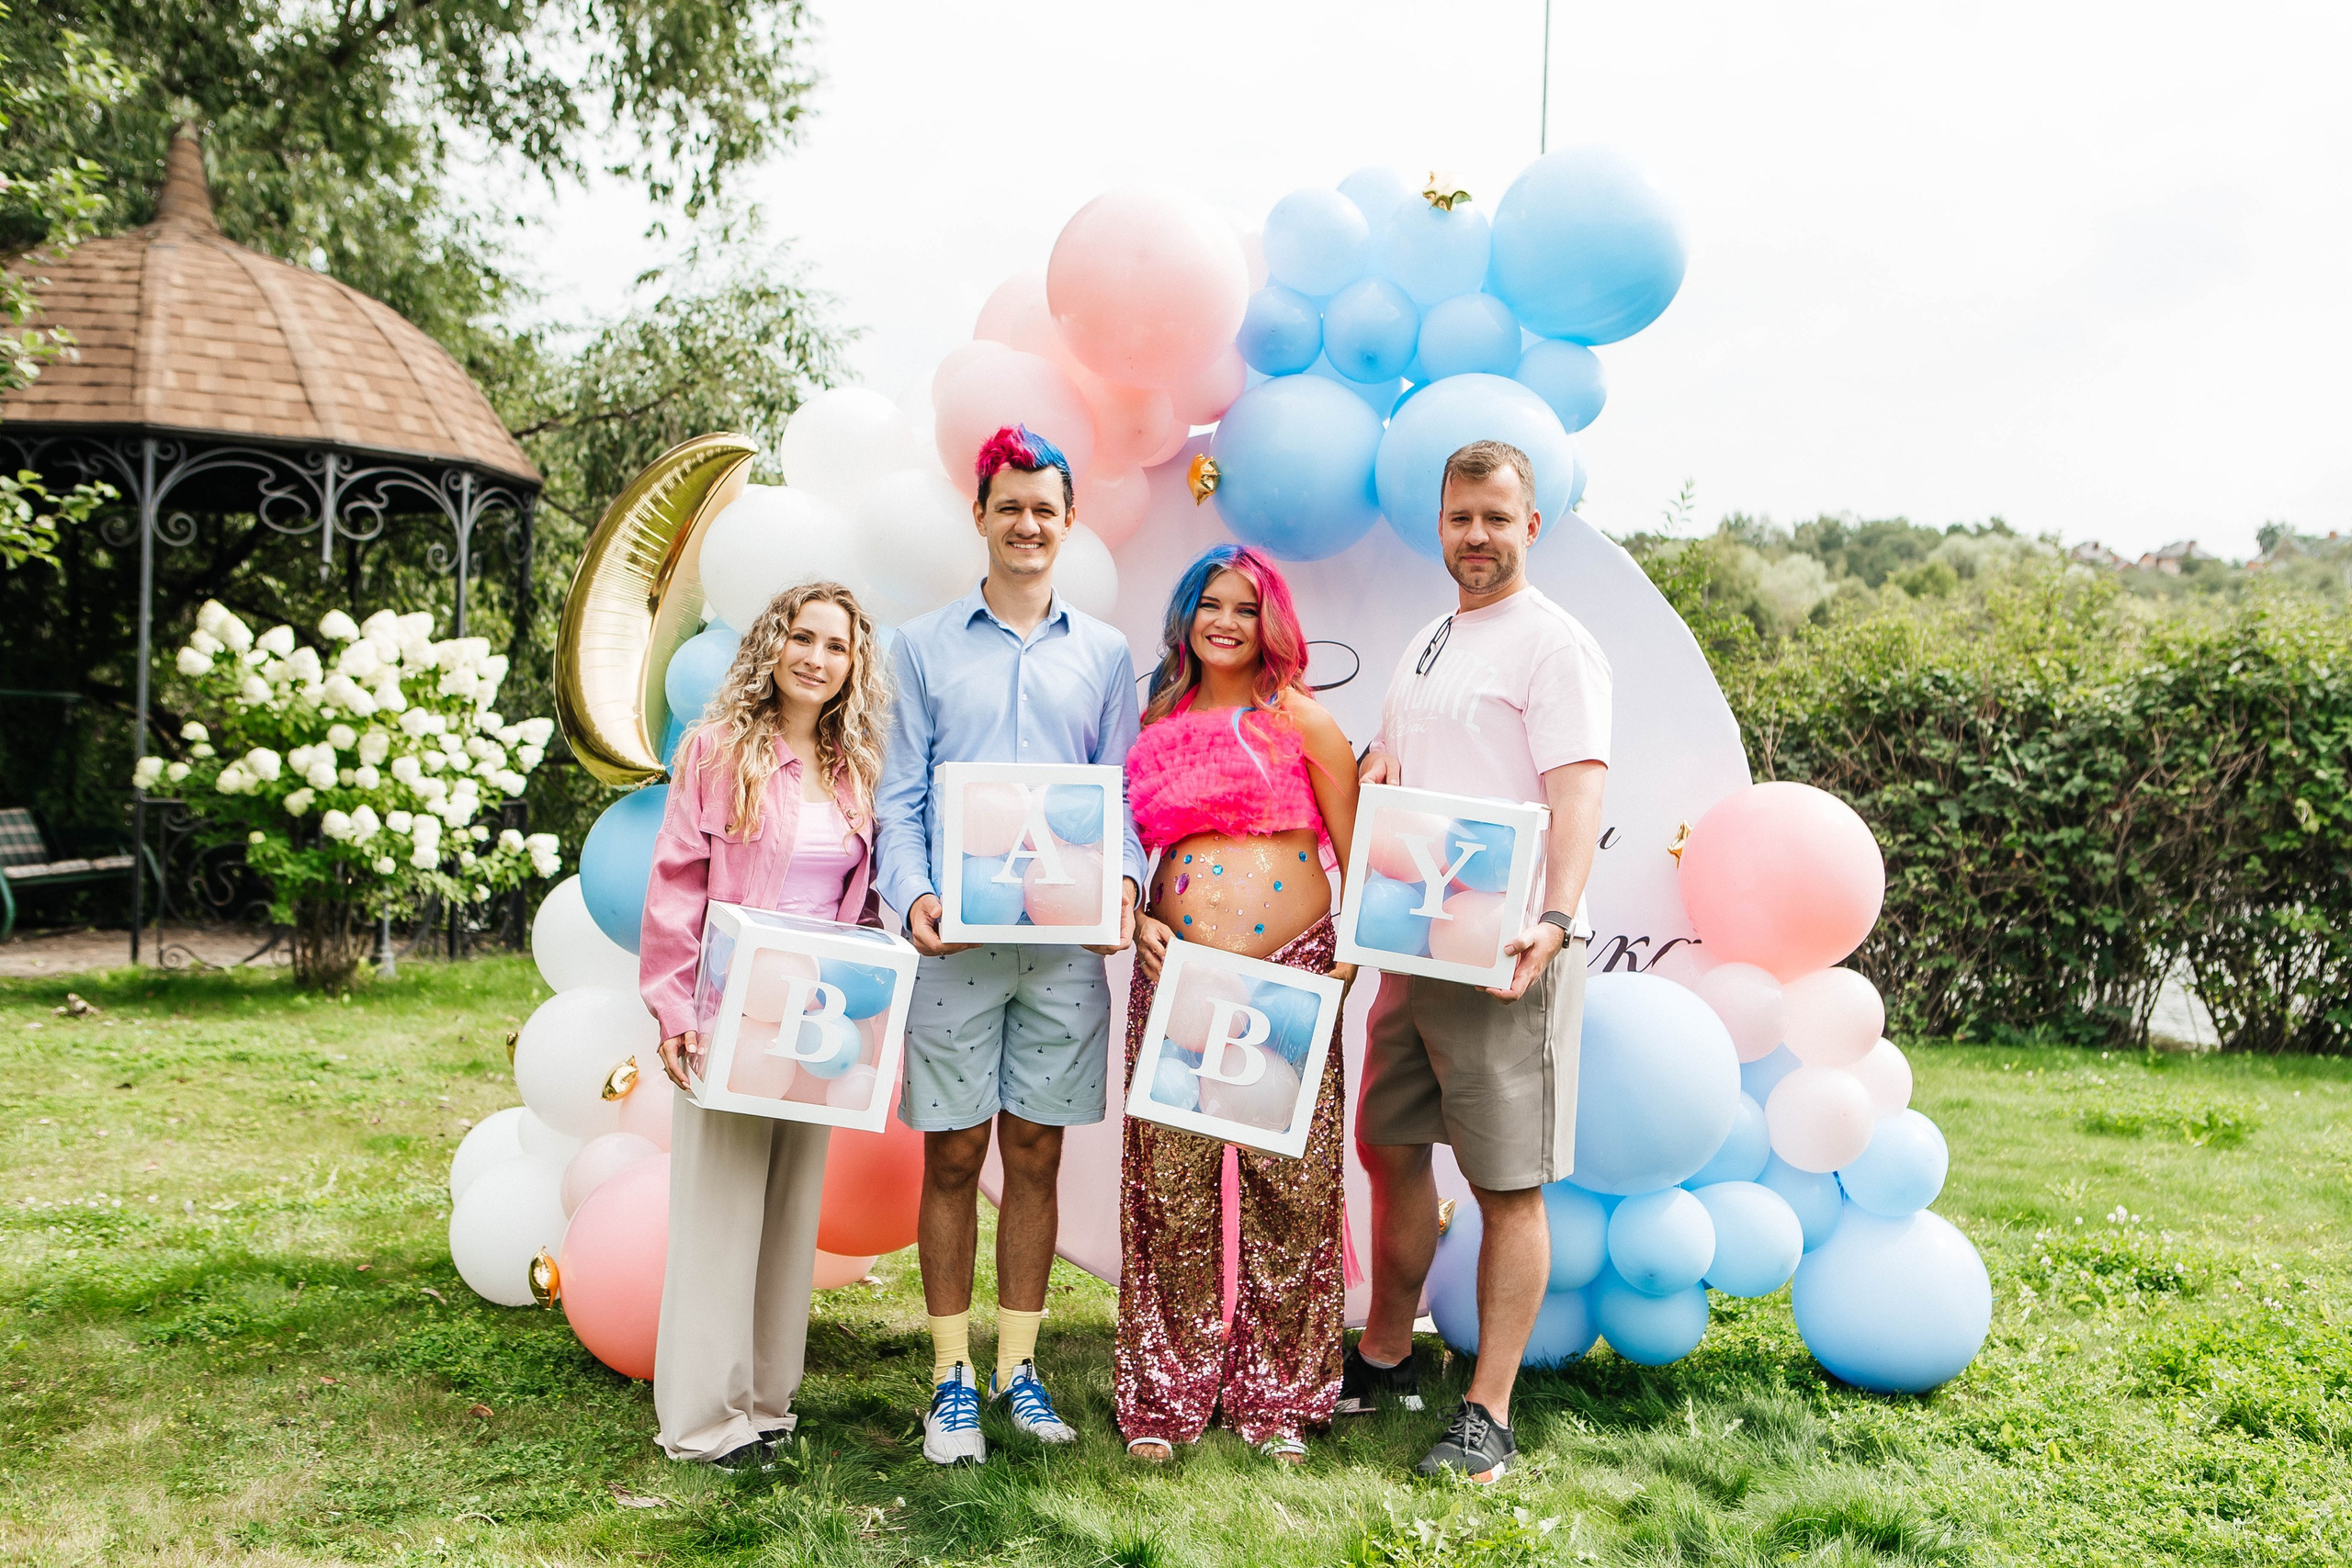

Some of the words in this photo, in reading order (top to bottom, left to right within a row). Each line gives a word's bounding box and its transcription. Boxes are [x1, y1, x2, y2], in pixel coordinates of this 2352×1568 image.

[990, 803, 1076, 885] A
[1395, 831, 1487, 921] Y
[763, 975, 847, 1063] B
[1188, 996, 1272, 1087] B
